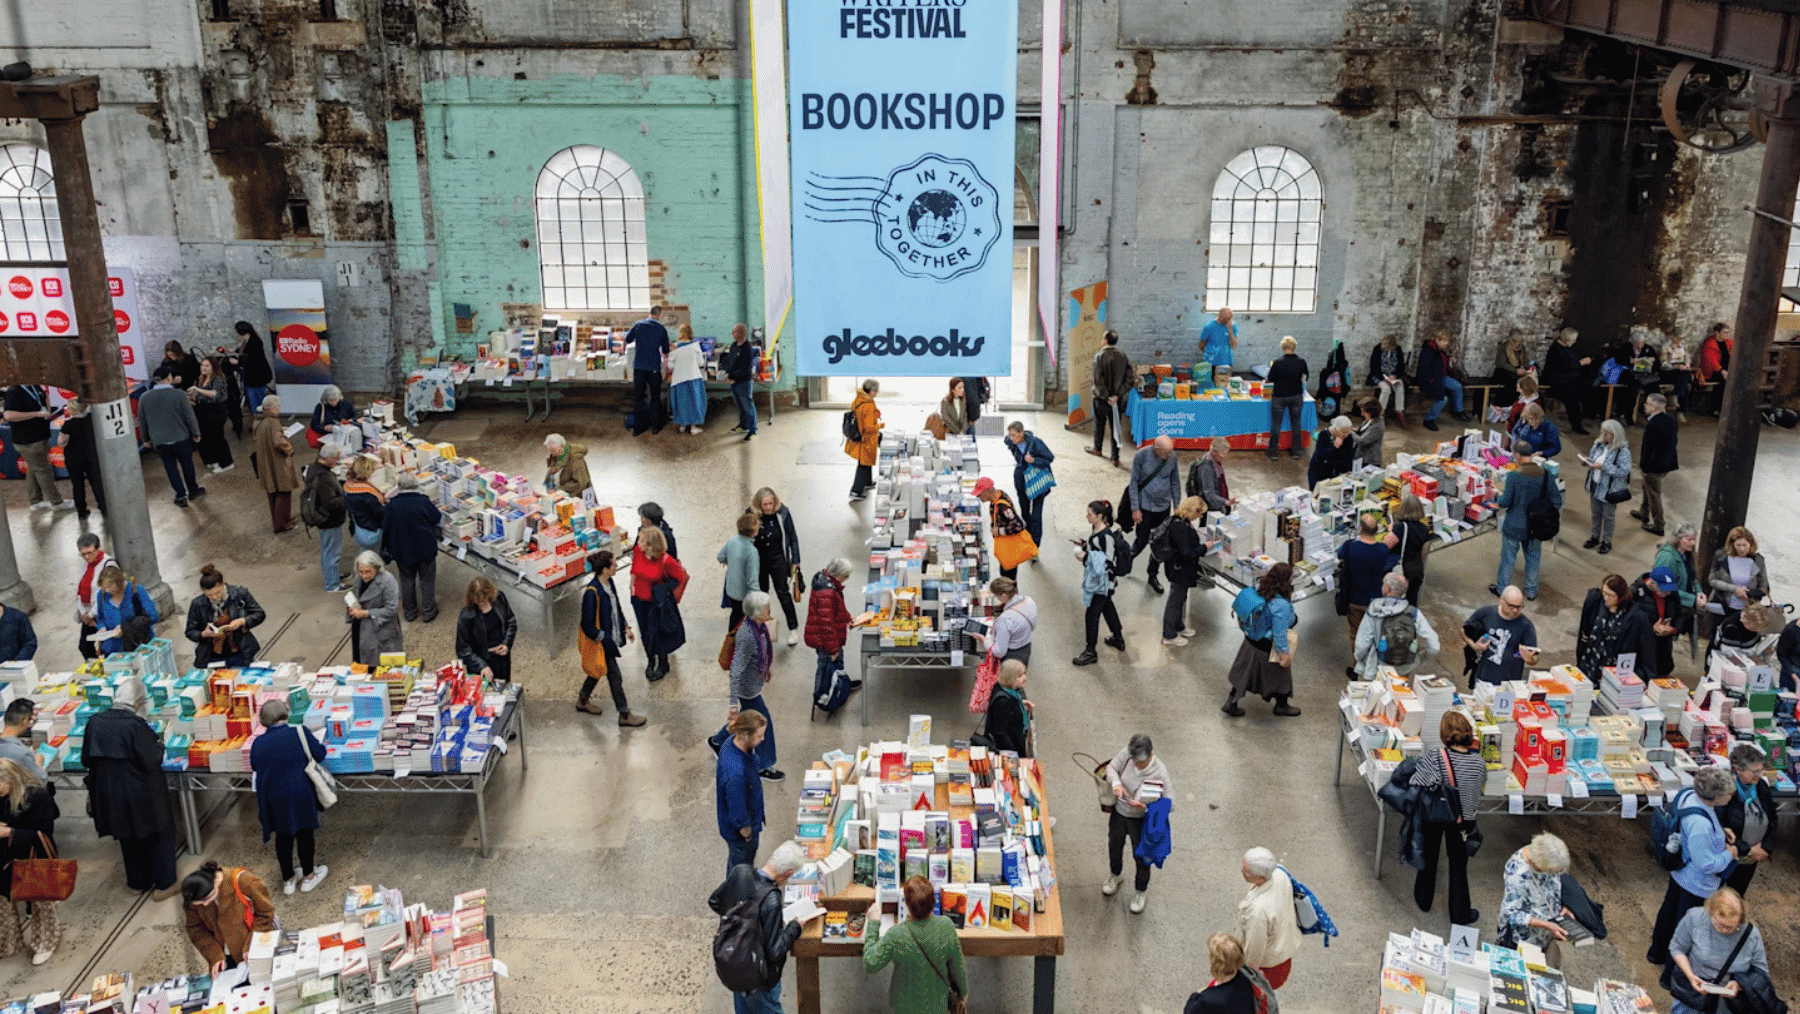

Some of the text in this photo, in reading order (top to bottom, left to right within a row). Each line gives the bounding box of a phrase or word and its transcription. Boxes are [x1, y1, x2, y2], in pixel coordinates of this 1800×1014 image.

[840, 8, 966, 39] FESTIVAL
[802, 93, 1004, 130] BOOKSHOP
[916, 169, 983, 207] IN THIS
[887, 215, 971, 268] TOGETHER
[280, 343, 317, 353] SYDNEY
[822, 329, 985, 364] gleebooks
[106, 403, 122, 420] J1
[1157, 412, 1195, 422] Reading
[114, 420, 124, 435] 2
[1157, 420, 1186, 429] opens
[1157, 427, 1184, 435] doors
[1620, 659, 1631, 670] G
[1757, 673, 1767, 683] E
[1499, 698, 1509, 709] D
[1456, 935, 1470, 948] A
